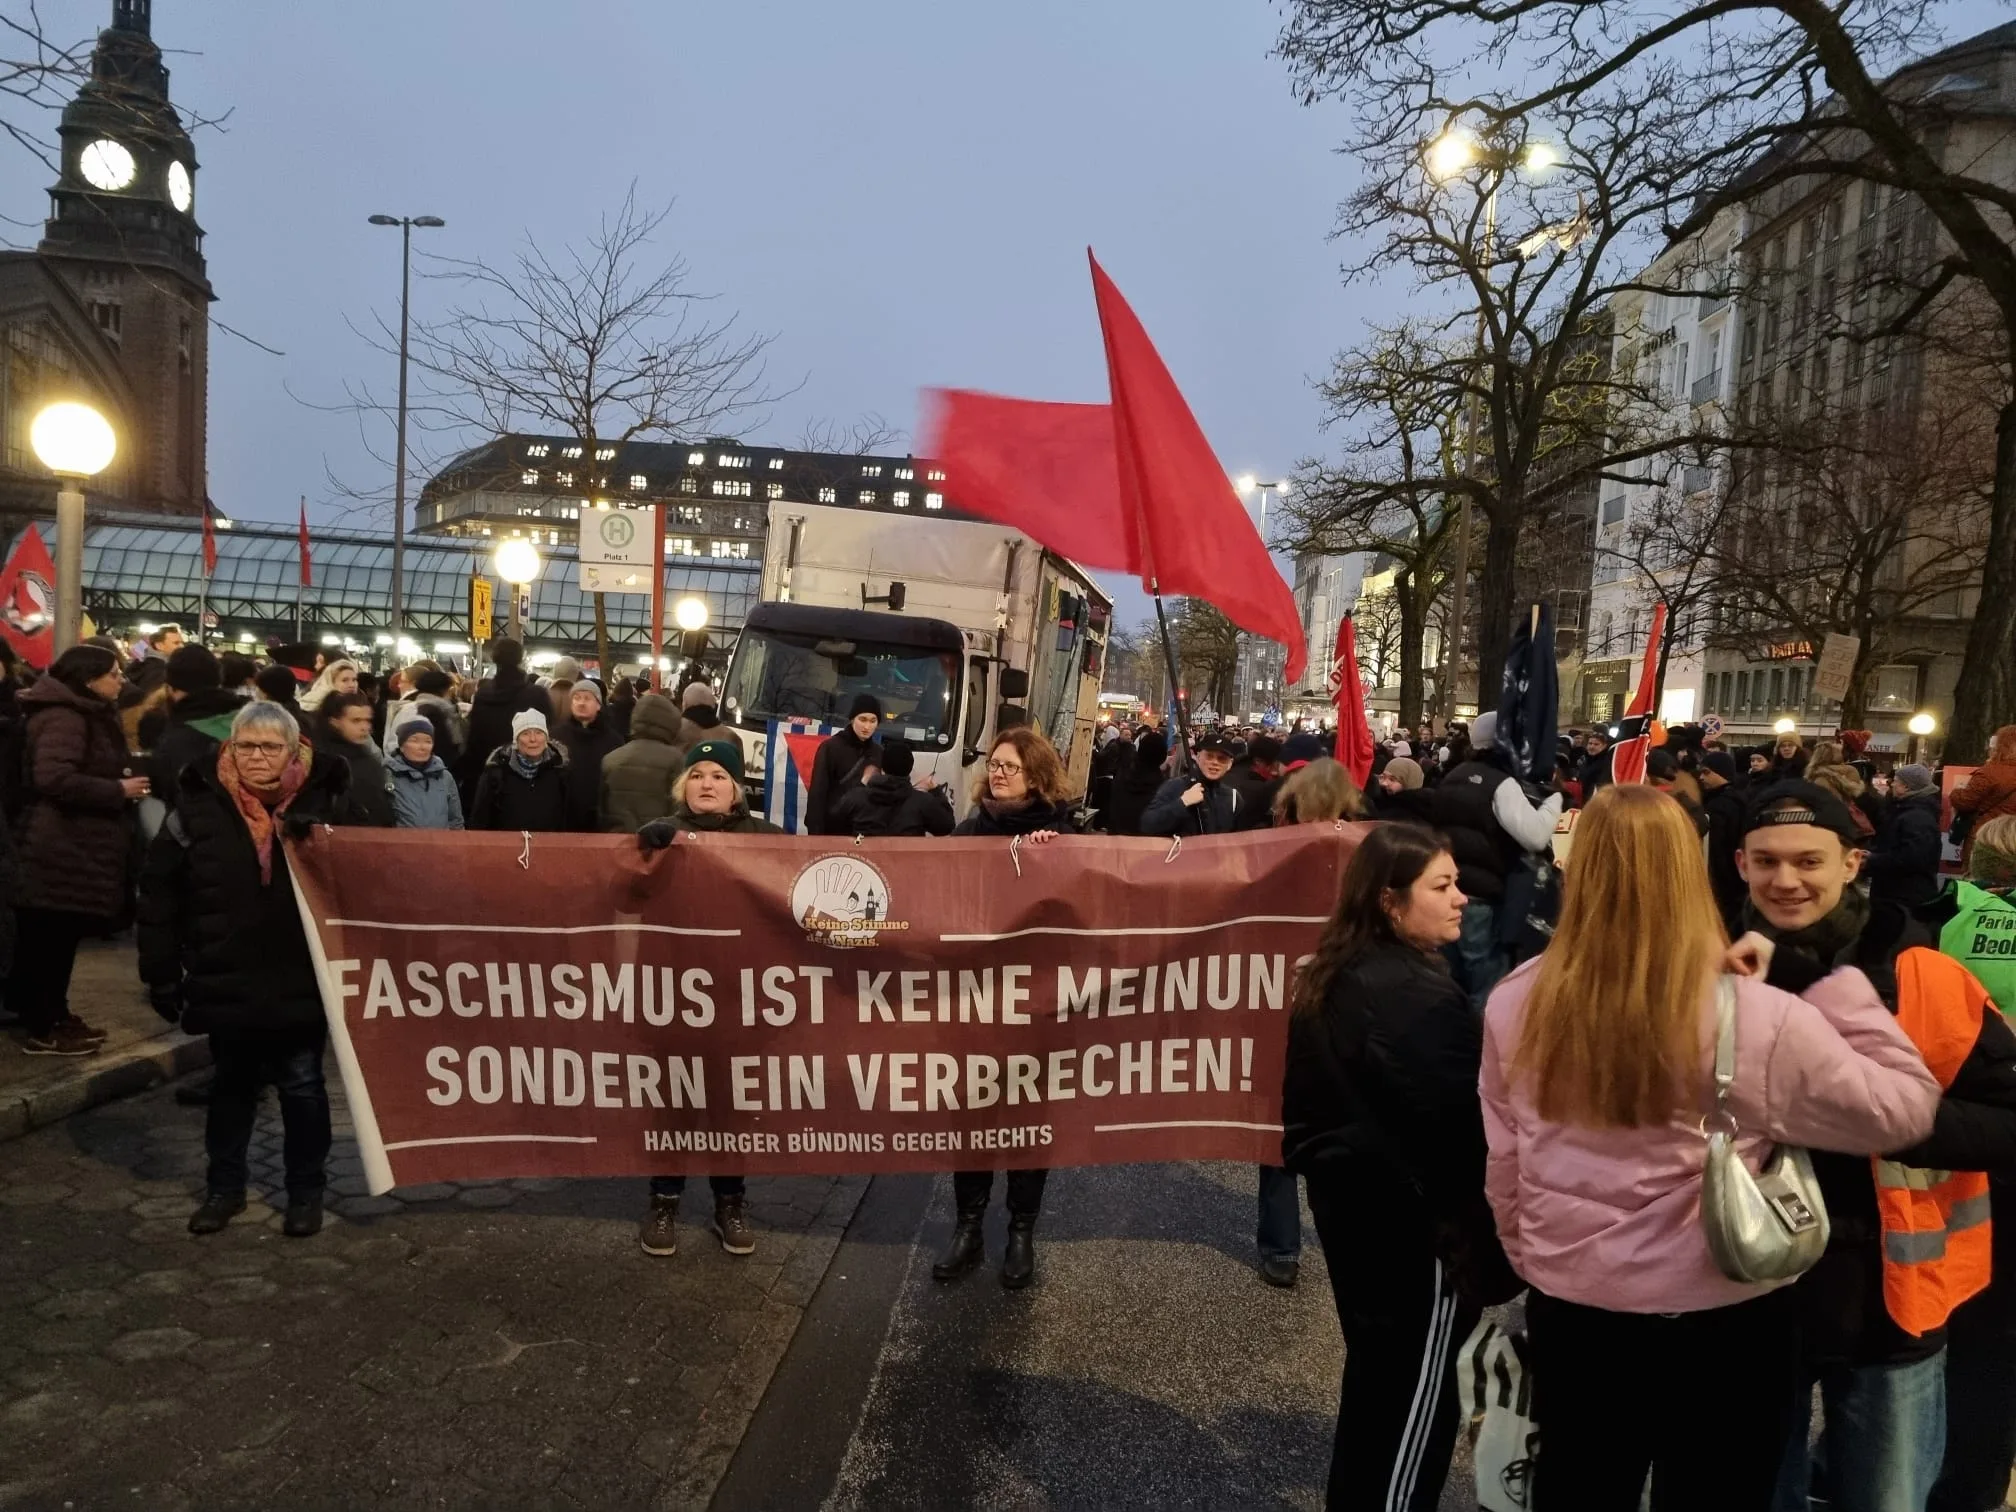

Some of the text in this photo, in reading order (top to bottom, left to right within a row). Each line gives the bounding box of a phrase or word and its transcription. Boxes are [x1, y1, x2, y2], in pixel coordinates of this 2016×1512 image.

[603, 553, 629, 561] Platz 1
[743, 784, 765, 797] AF
[804, 916, 910, 931] Keine Stimme
[1975, 914, 2016, 930] Parla
[834, 934, 880, 947] Nazis.
[327, 953, 1316, 1028] FASCHISMUS IST KEINE MEINUN
[425, 1037, 1254, 1113] SONDERN EIN VERBRECHEN!
[644, 1124, 1054, 1154] HAMBURGER BÜNDNIS GEGEN RECHTS
